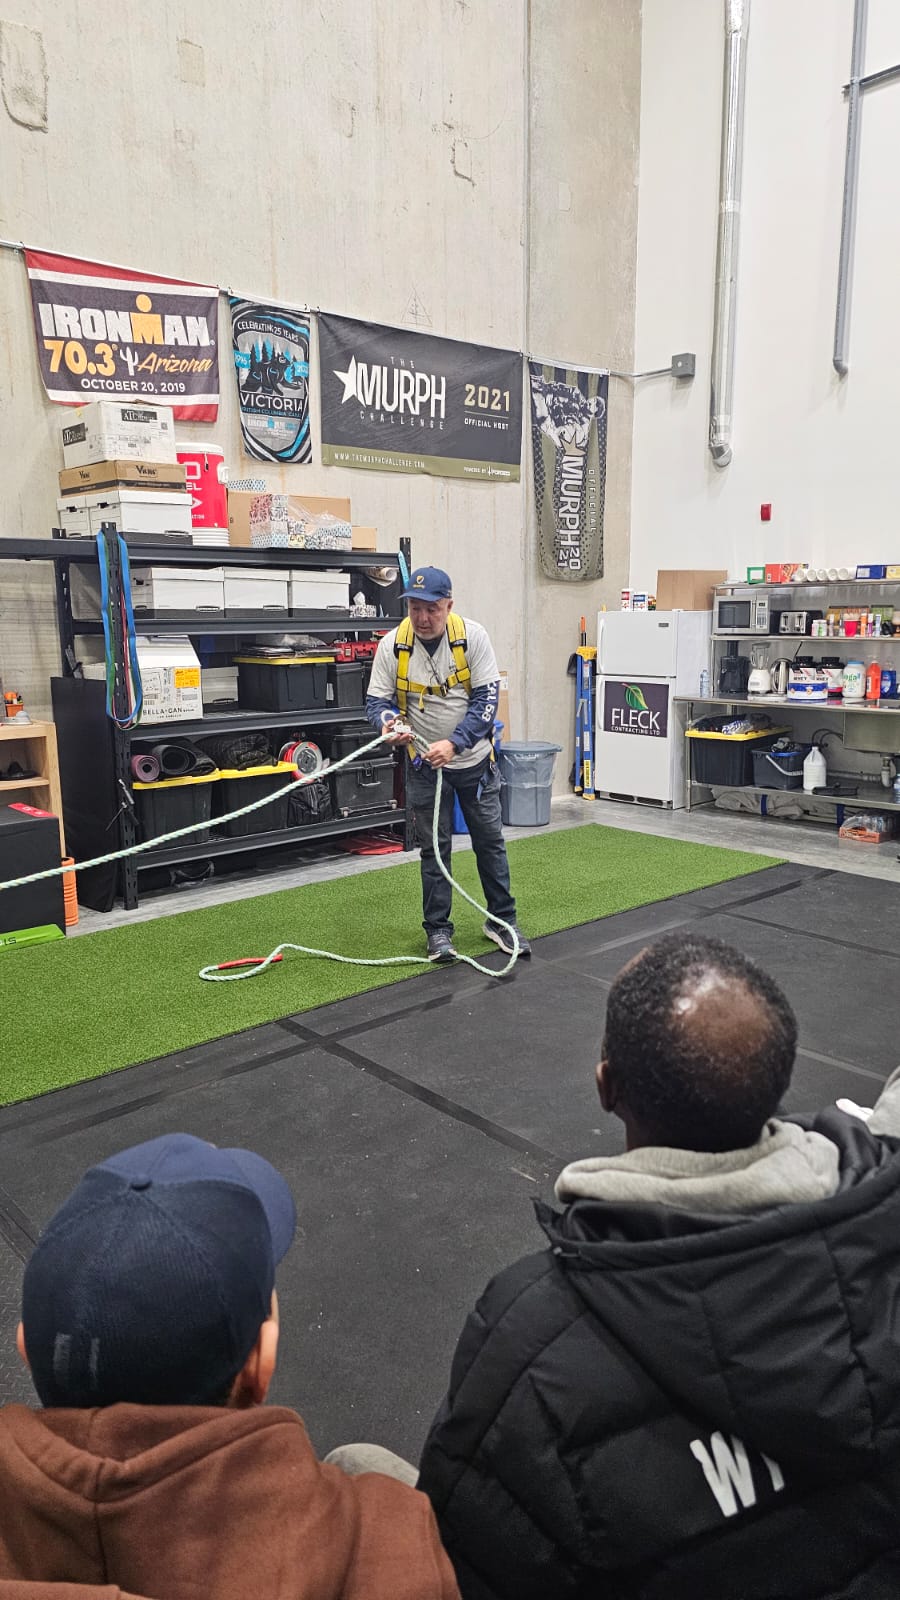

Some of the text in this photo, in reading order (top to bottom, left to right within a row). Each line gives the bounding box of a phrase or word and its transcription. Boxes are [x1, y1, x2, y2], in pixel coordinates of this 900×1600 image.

[43, 339, 213, 377] 70.3 Arizona
[390, 356, 415, 369] THE
[81, 378, 186, 393] OCTOBER 20, 2019
[357, 362, 446, 419] MURPH
[240, 393, 303, 412] VICTORIA
[464, 383, 510, 412] 2021
[360, 410, 444, 430] CHALLENGE
[464, 417, 509, 430] OFFICIAL HOST
[558, 455, 584, 546] MURPH
[588, 469, 596, 532] OFFICIAL
[611, 708, 661, 730] FLECK
[611, 725, 649, 735] CONTRACTING
